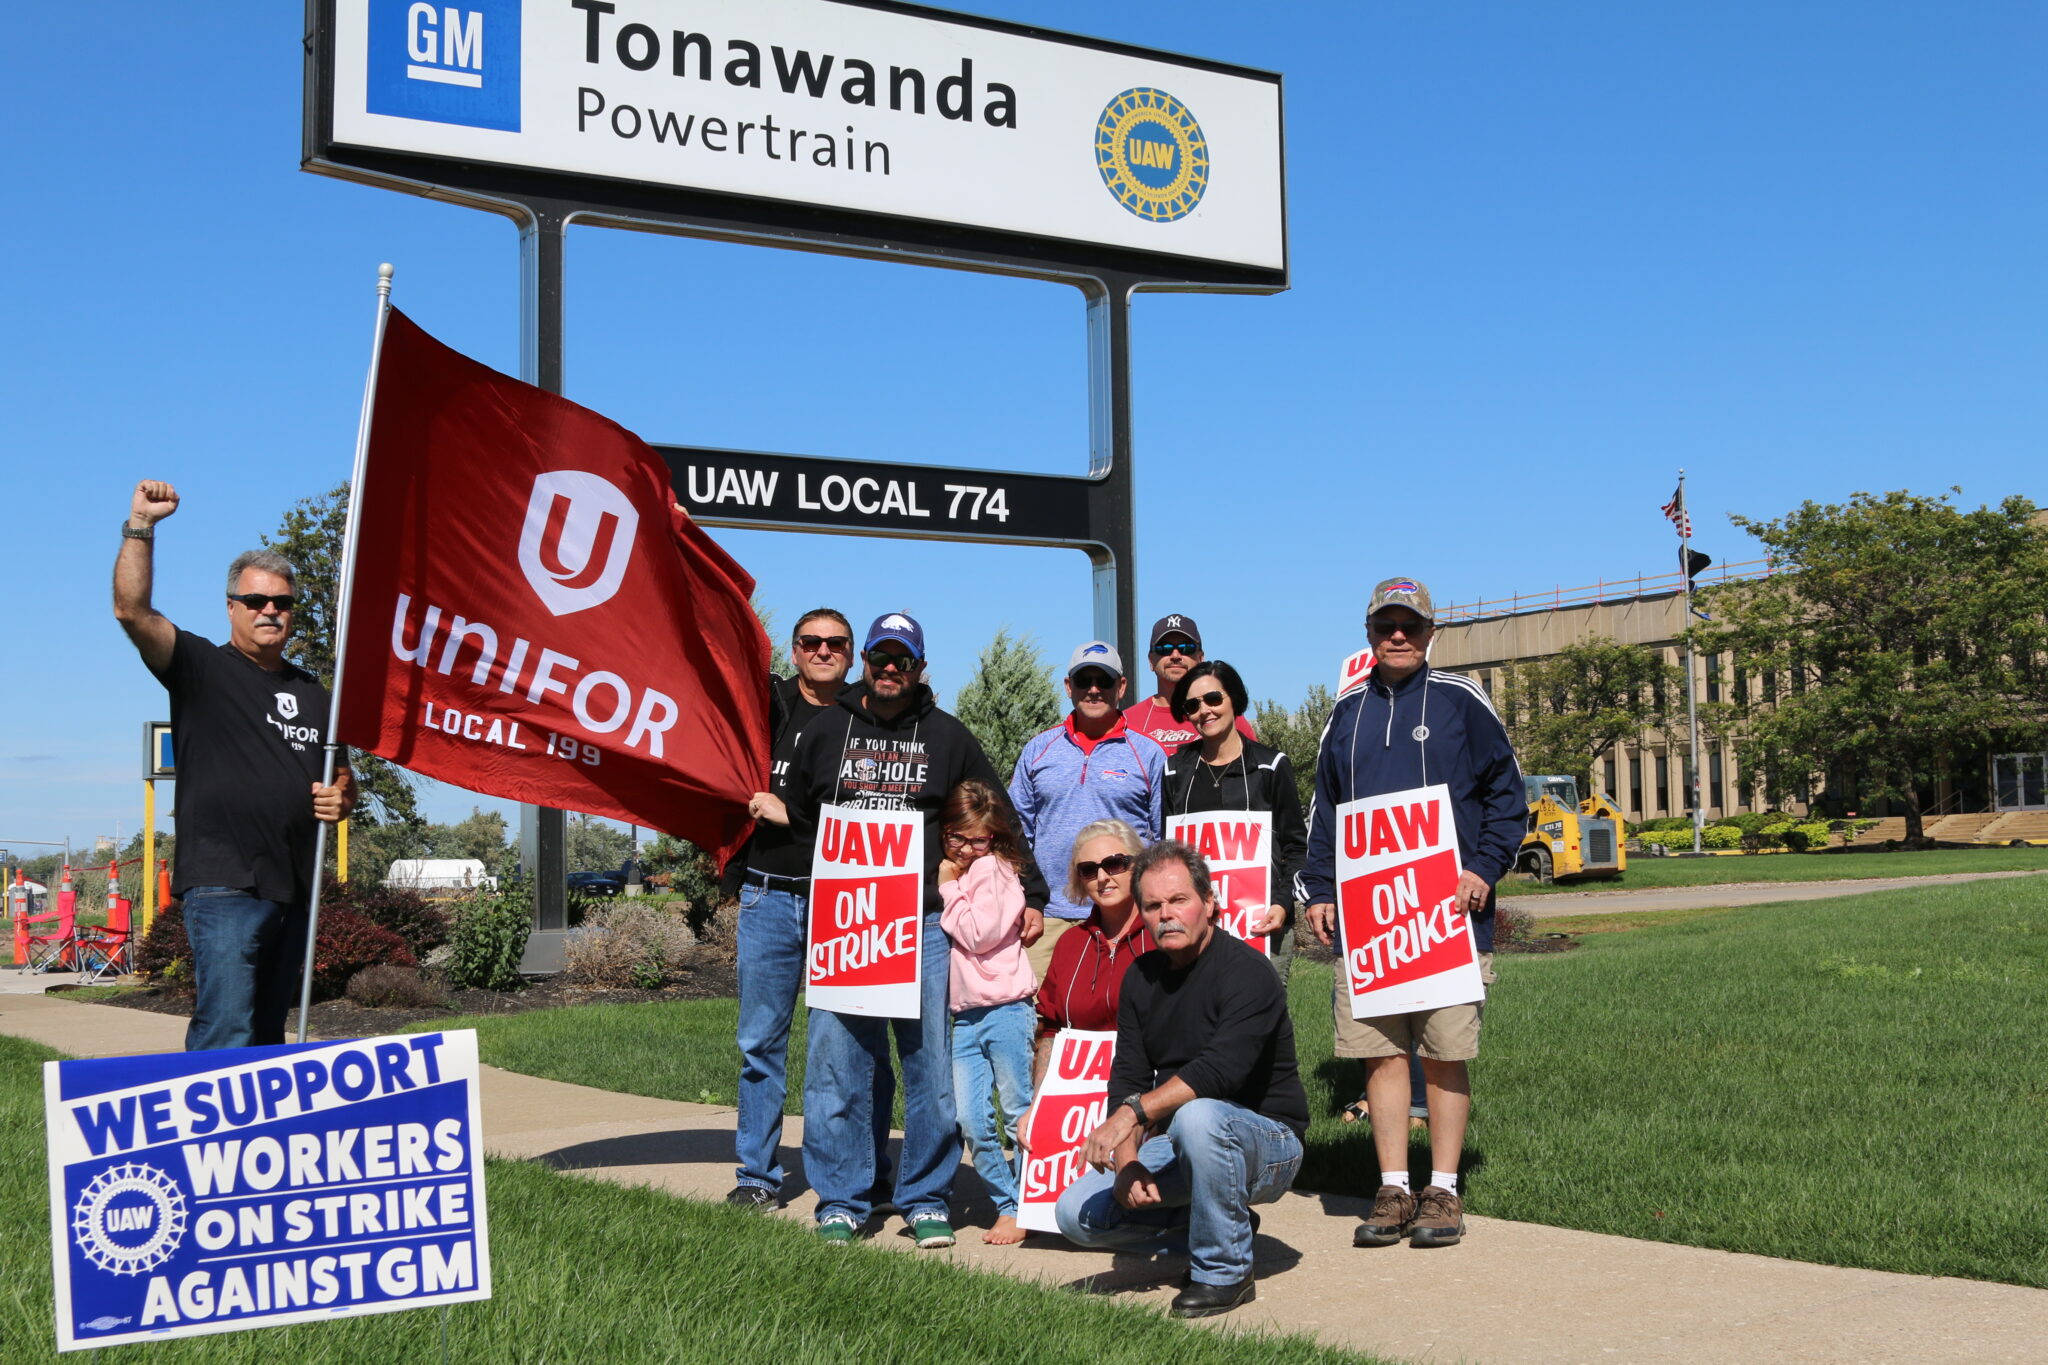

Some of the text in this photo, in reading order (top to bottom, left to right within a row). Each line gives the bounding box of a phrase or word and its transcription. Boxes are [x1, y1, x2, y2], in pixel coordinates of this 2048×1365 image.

[407, 2, 483, 70] GM
[571, 0, 1017, 129] Tonawanda
[578, 86, 890, 176] Powertrain
[1129, 138, 1175, 170] UAW
[688, 465, 1010, 523] UAW LOCAL 774
[424, 701, 601, 767] LOCAL 199
[849, 737, 925, 753] IF YOU THINK
[821, 817, 914, 867] UAW
[1174, 821, 1263, 861] UAW
[1344, 799, 1440, 860] UAW
[834, 882, 878, 930] ON
[1372, 867, 1420, 926] ON
[810, 915, 918, 981] STRIKE
[1350, 894, 1467, 990] STRIKE
[1058, 1038, 1113, 1081] UA
[72, 1032, 444, 1156] WE SUPPORT
[181, 1118, 464, 1197] WORKERS
[1026, 1148, 1082, 1198] STR
[106, 1205, 154, 1233] UAW
[194, 1204, 274, 1251] ON
[283, 1182, 469, 1242] STRIKE
[140, 1240, 474, 1327] AGAINST GM
